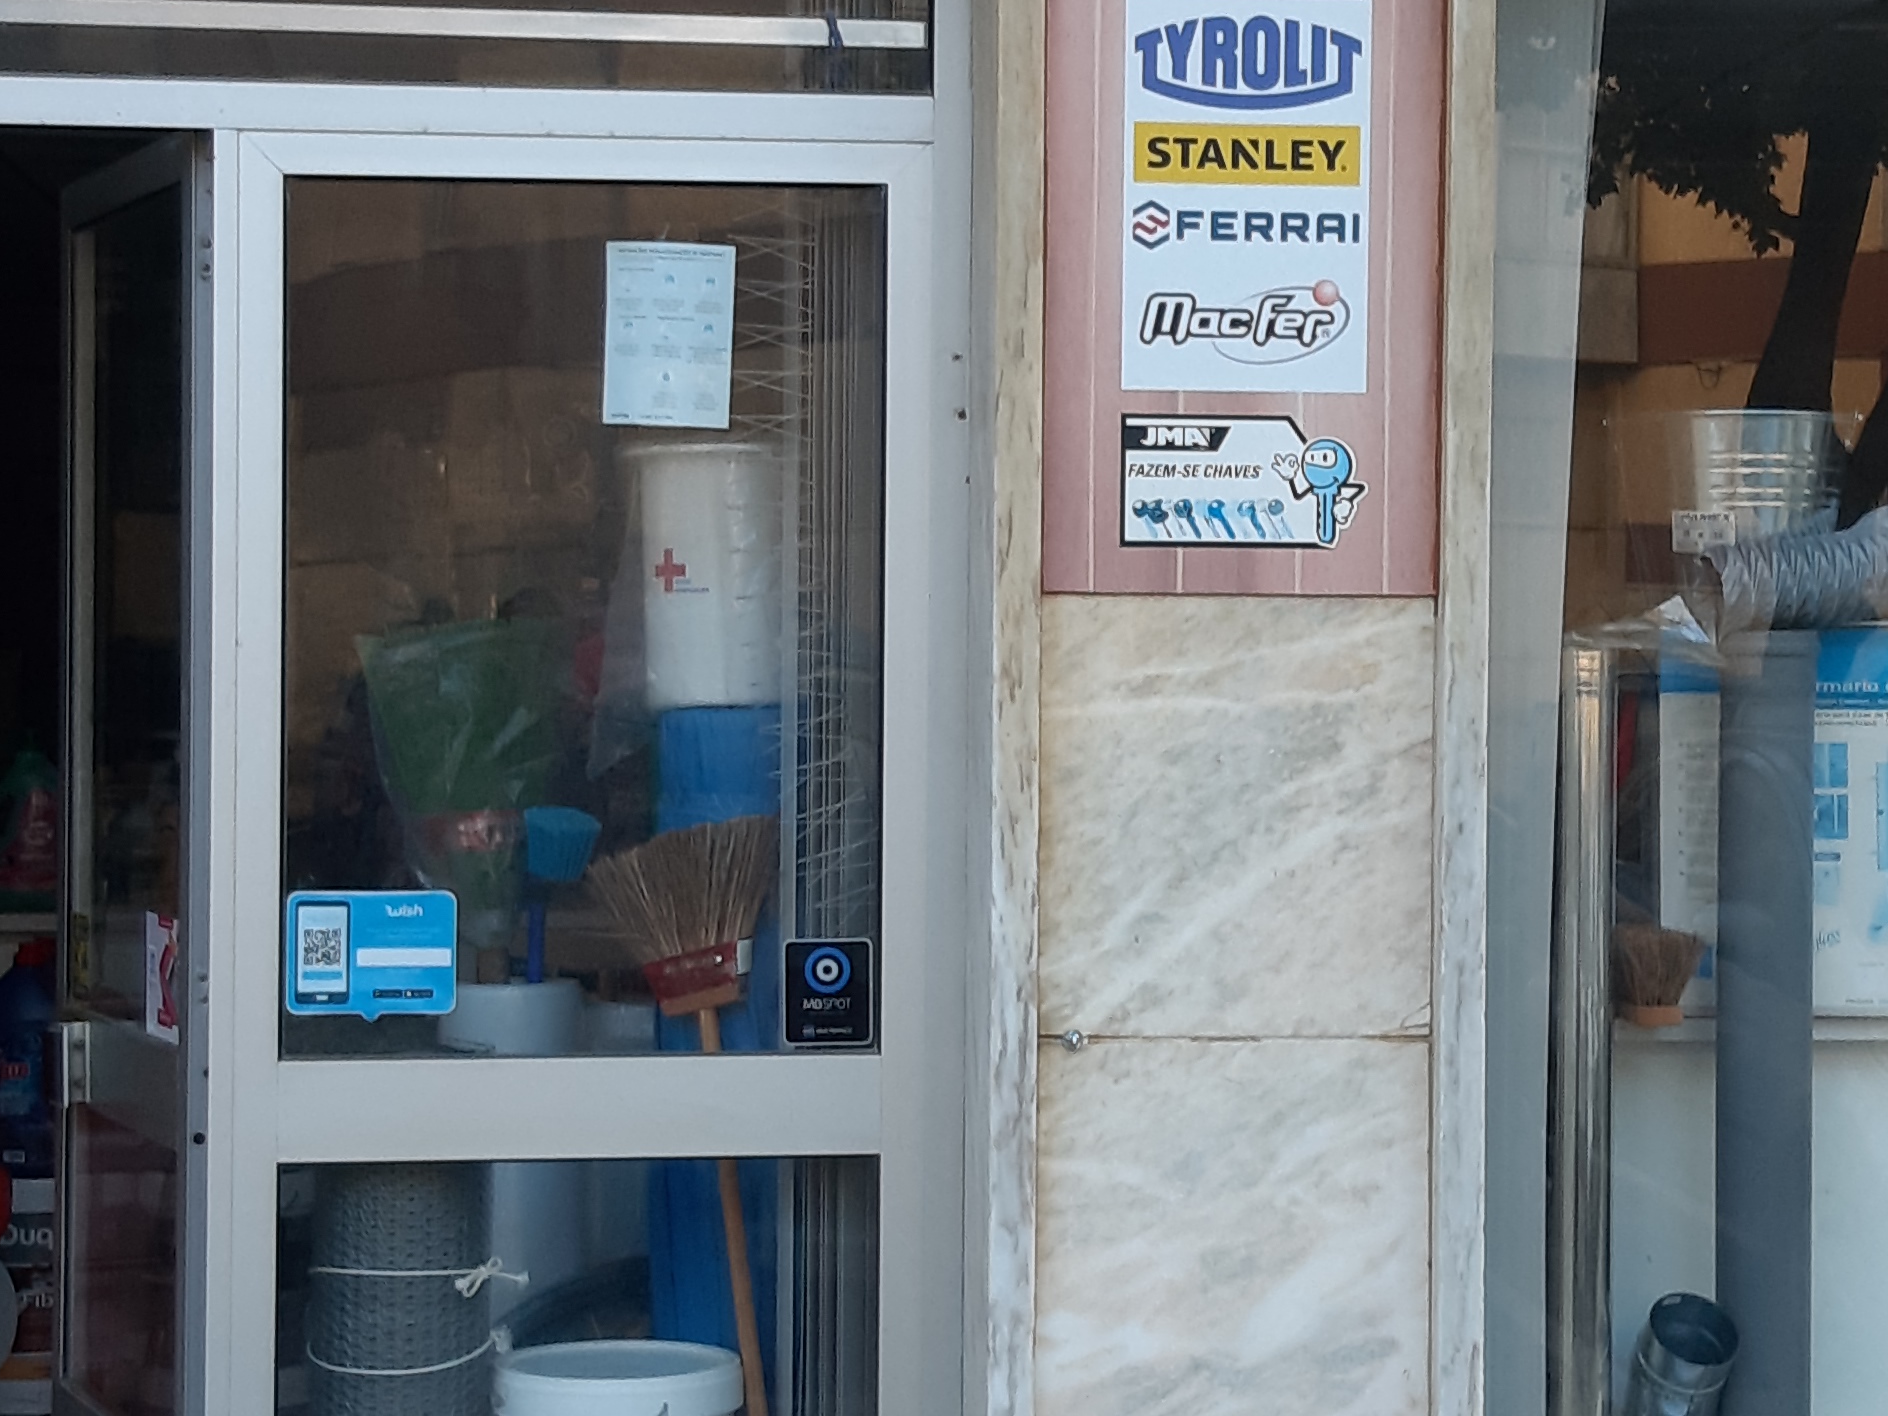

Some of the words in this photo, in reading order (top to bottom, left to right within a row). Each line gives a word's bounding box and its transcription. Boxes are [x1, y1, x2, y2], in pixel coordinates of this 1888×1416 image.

[1134, 15, 1363, 102] TYROLIT
[1176, 209, 1361, 244] FERRAI
[1139, 426, 1212, 448] JMA
[1127, 463, 1202, 480] FAZEM-SE
[1203, 464, 1263, 480] CHAVES
